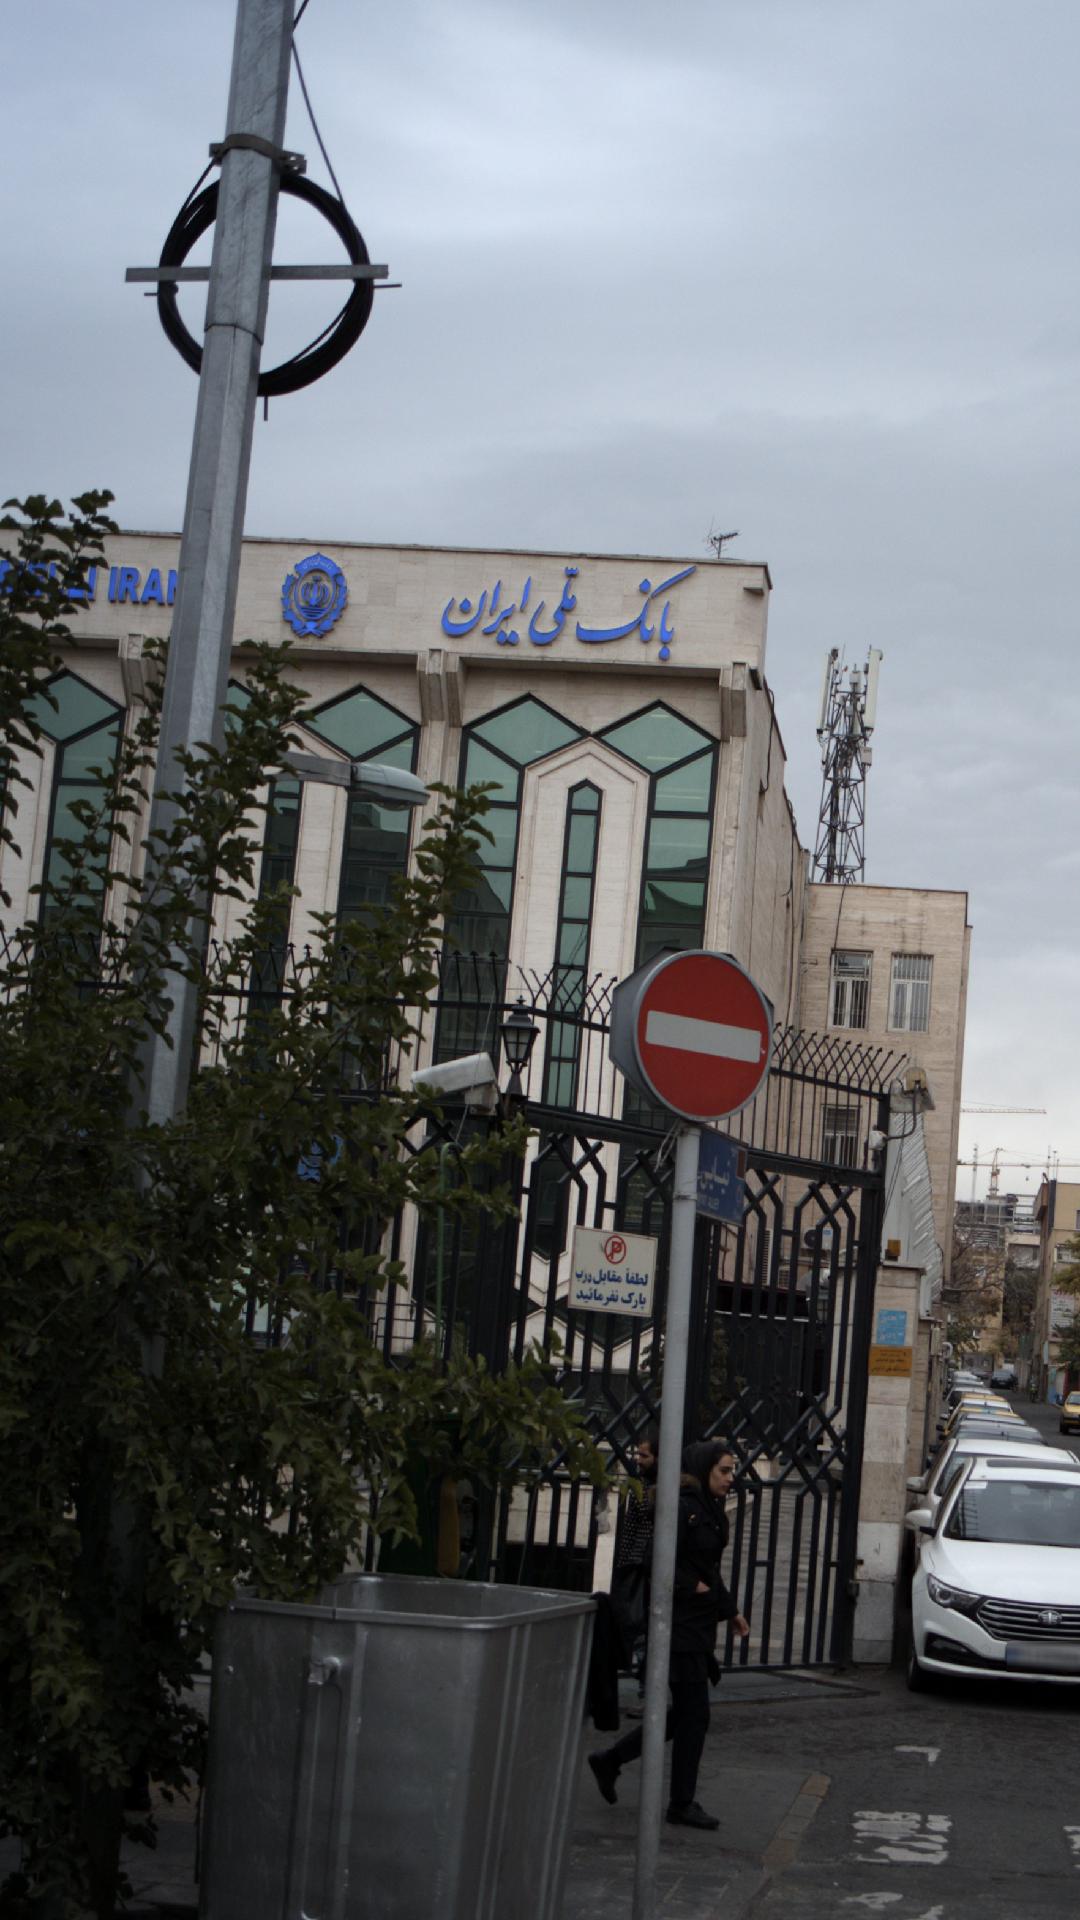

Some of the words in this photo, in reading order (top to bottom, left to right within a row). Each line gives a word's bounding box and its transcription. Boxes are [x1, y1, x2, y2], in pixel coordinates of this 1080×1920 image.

[441, 576, 532, 645] ایران
[576, 565, 696, 660] بانک
[575, 1270, 592, 1284] درب
[593, 1268, 622, 1285] مقابل
[621, 1291, 646, 1310] پارک
